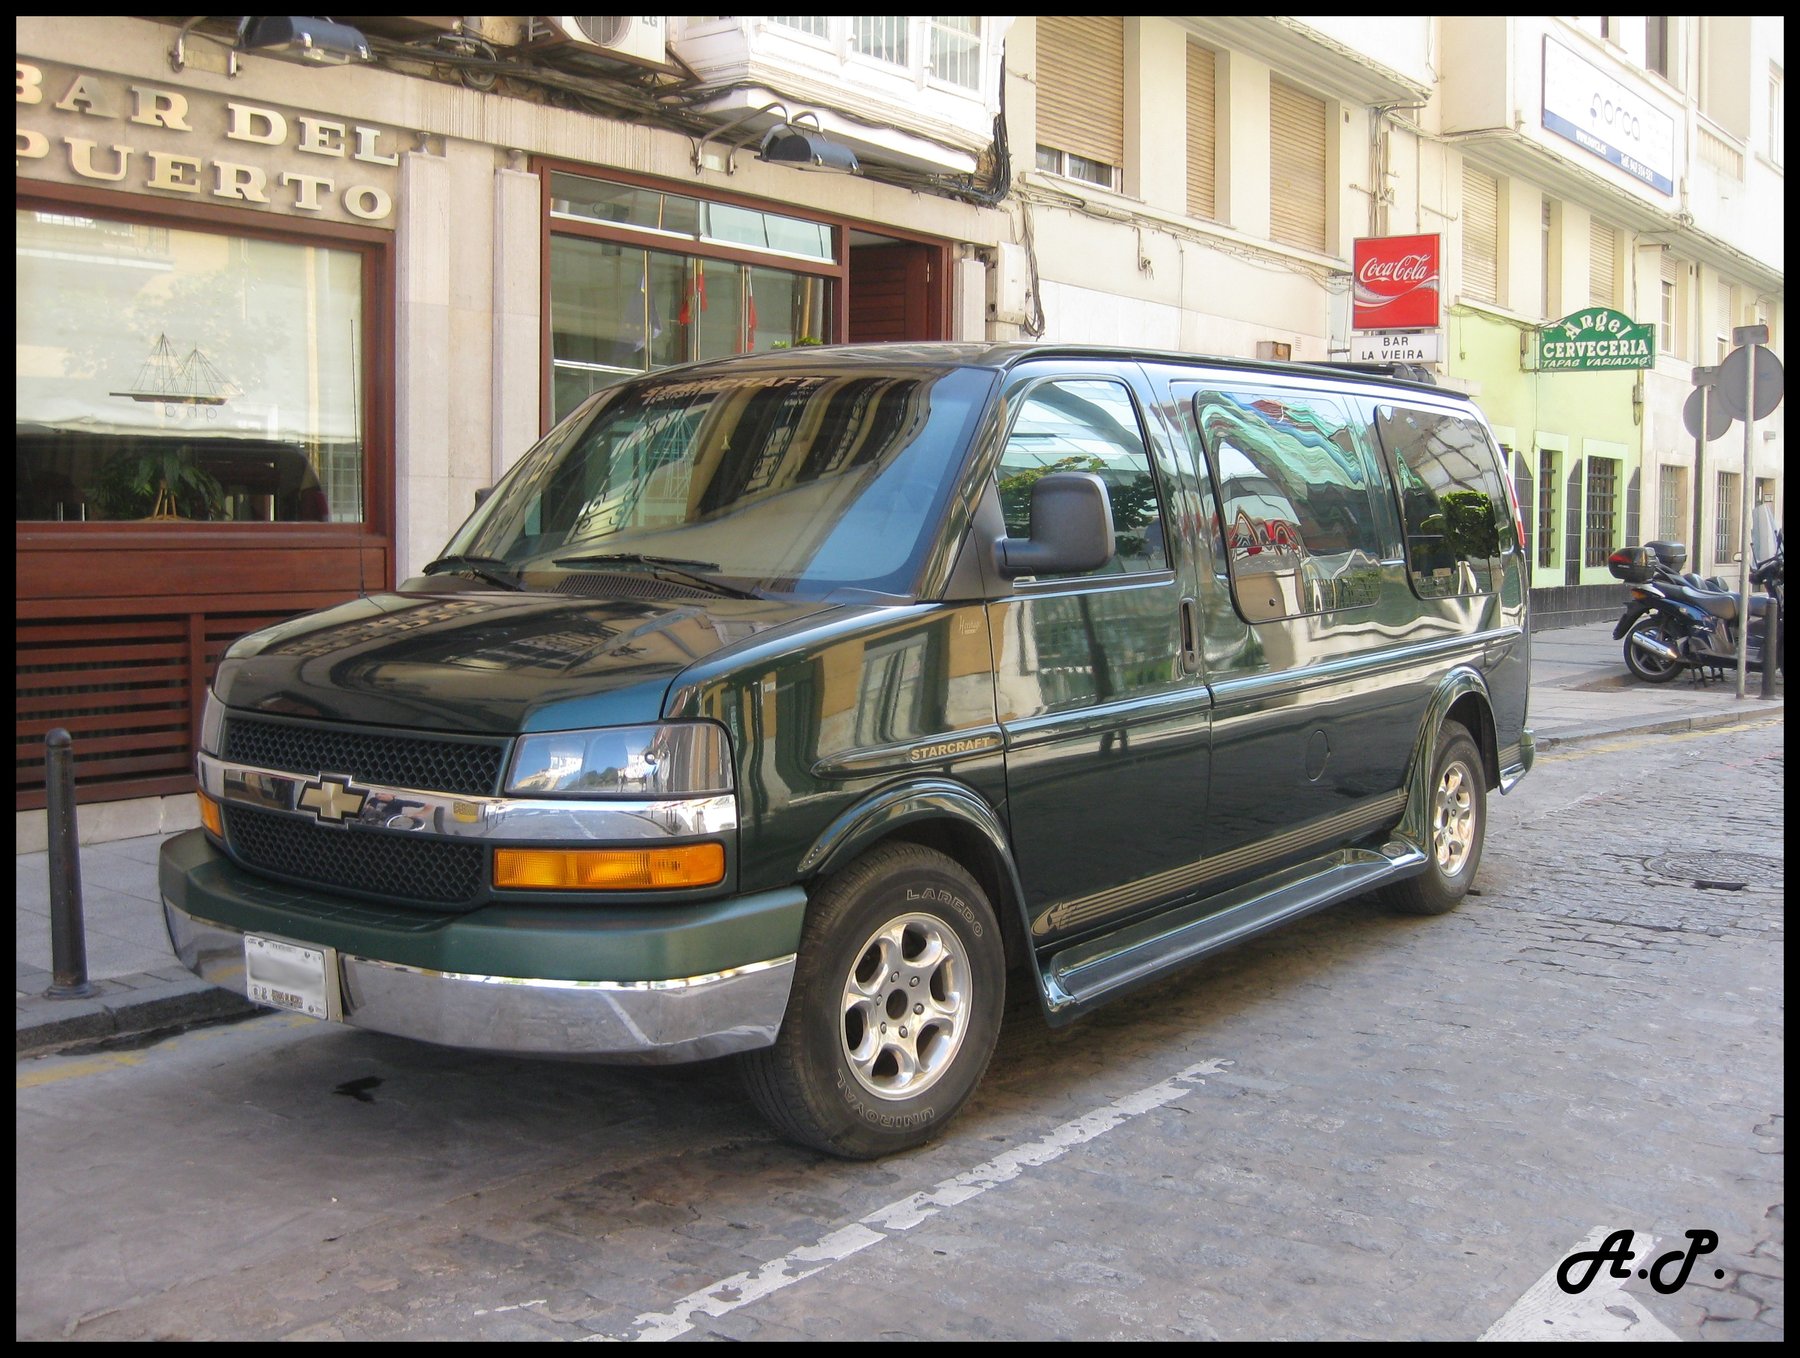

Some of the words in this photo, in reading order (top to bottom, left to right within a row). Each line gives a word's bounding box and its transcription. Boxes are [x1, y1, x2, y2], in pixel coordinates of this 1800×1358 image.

[227, 103, 399, 167] DEL
[1360, 254, 1431, 283] Coca-Cola
[1563, 310, 1633, 341] Angel
[1361, 351, 1375, 361] LA
[1382, 349, 1424, 360] VIEIRA
[1383, 336, 1409, 347] BAR
[1543, 339, 1649, 358] CERVECERIA
[1543, 359, 1580, 368] TAPAS
[1586, 356, 1648, 367] VARIADAS
[911, 736, 991, 762] STARCRAFT
[906, 887, 983, 938] LAREDO
[837, 1068, 935, 1129] UNIROYAL
